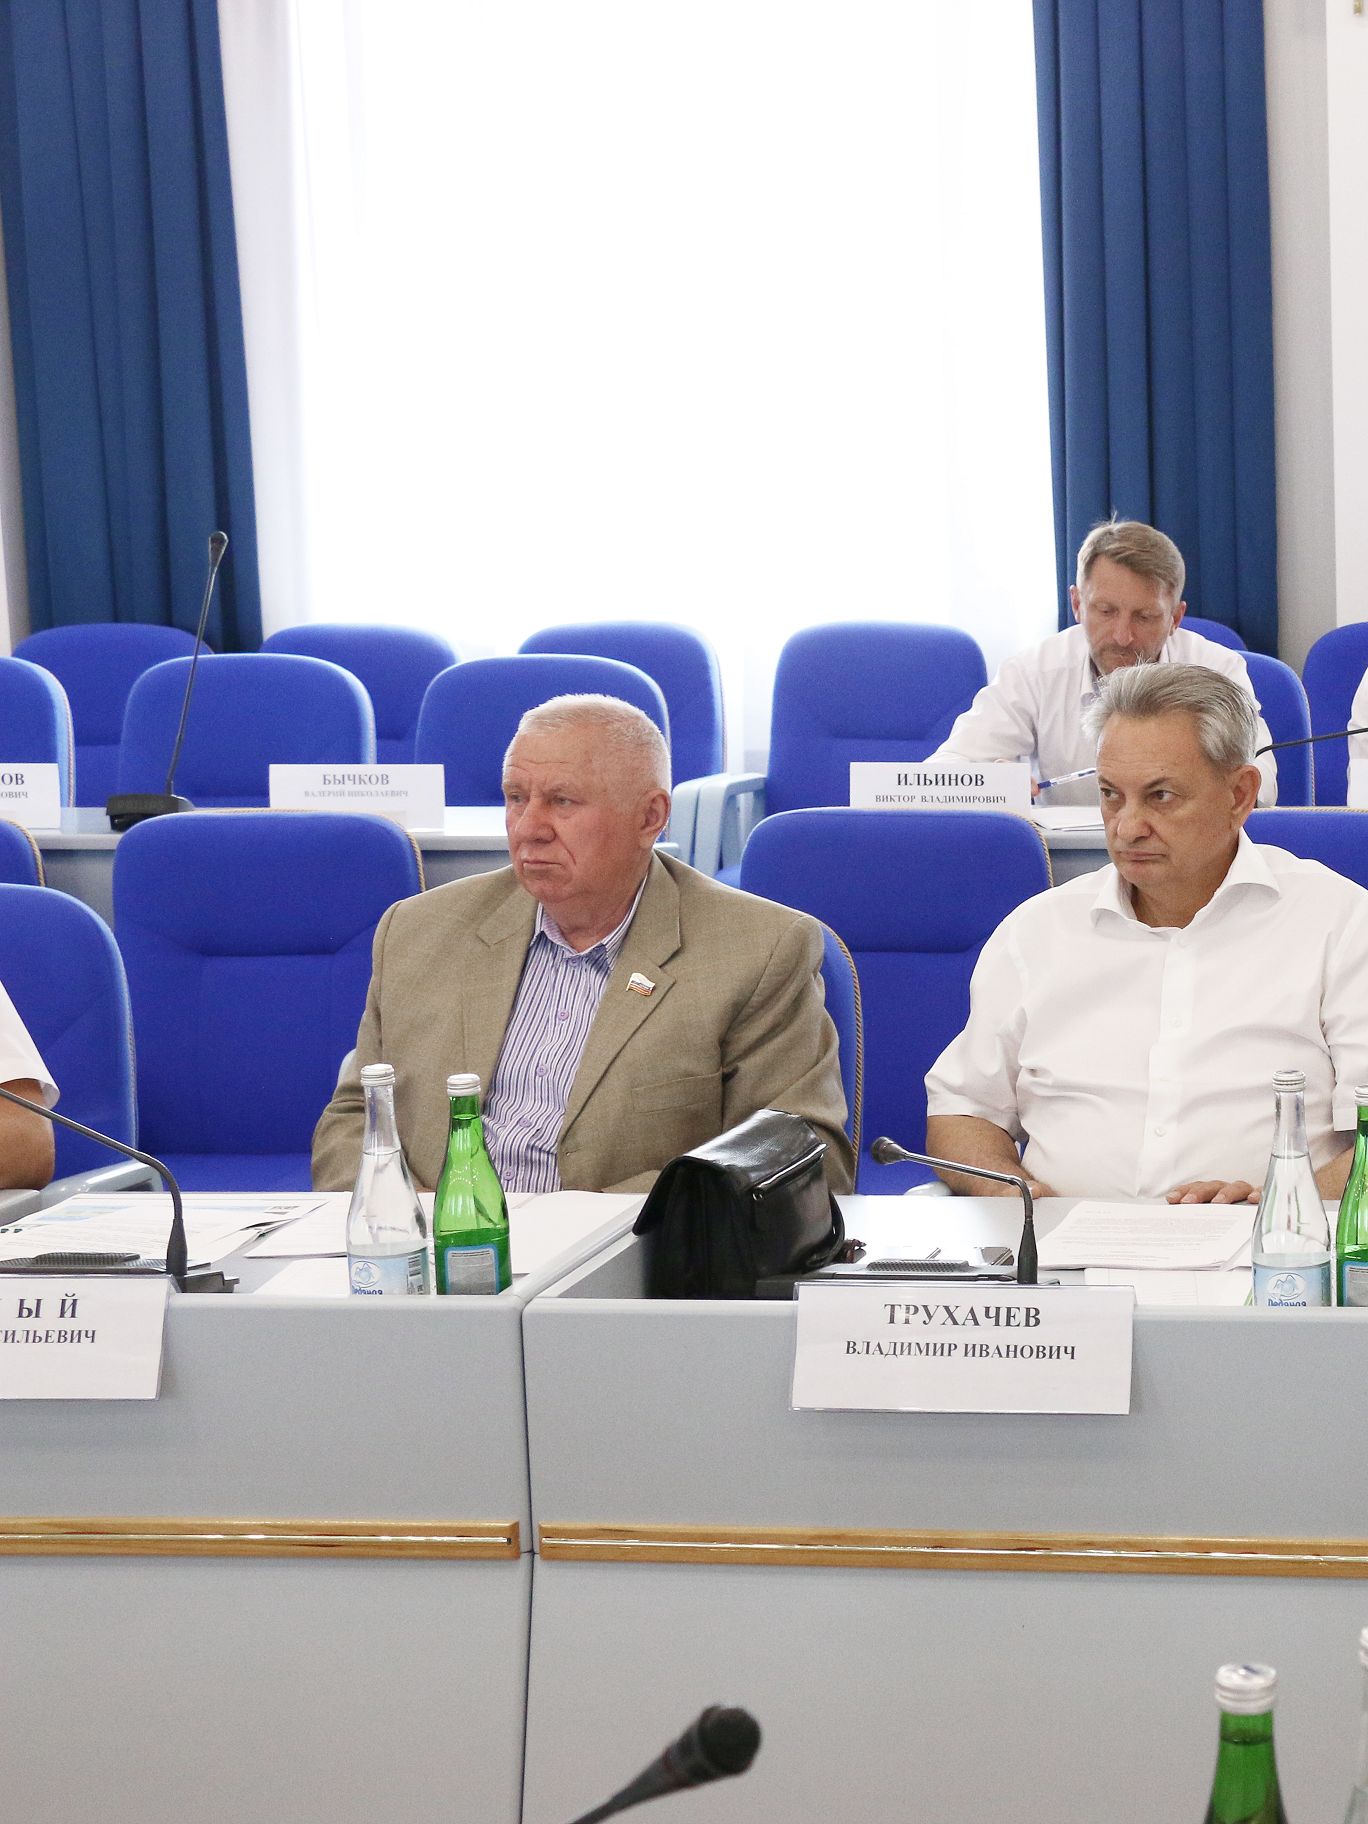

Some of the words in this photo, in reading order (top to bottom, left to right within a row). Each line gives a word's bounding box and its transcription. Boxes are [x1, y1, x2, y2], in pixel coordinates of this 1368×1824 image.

[322, 773, 389, 786] БЫЧКОВ
[897, 773, 985, 787] ИЛЬИНОВ
[875, 794, 916, 803] ВИКТОР
[921, 794, 1006, 804] ВЛАДИМИРОВИЧ
[884, 1303, 1041, 1328] ТРУХАЧЕВ
[0, 1329, 97, 1344] ИЛЬЕВИЧ
[845, 1340, 958, 1358] ВЛАДИМИР
[963, 1343, 1077, 1360] ИВАНОВИЧ
